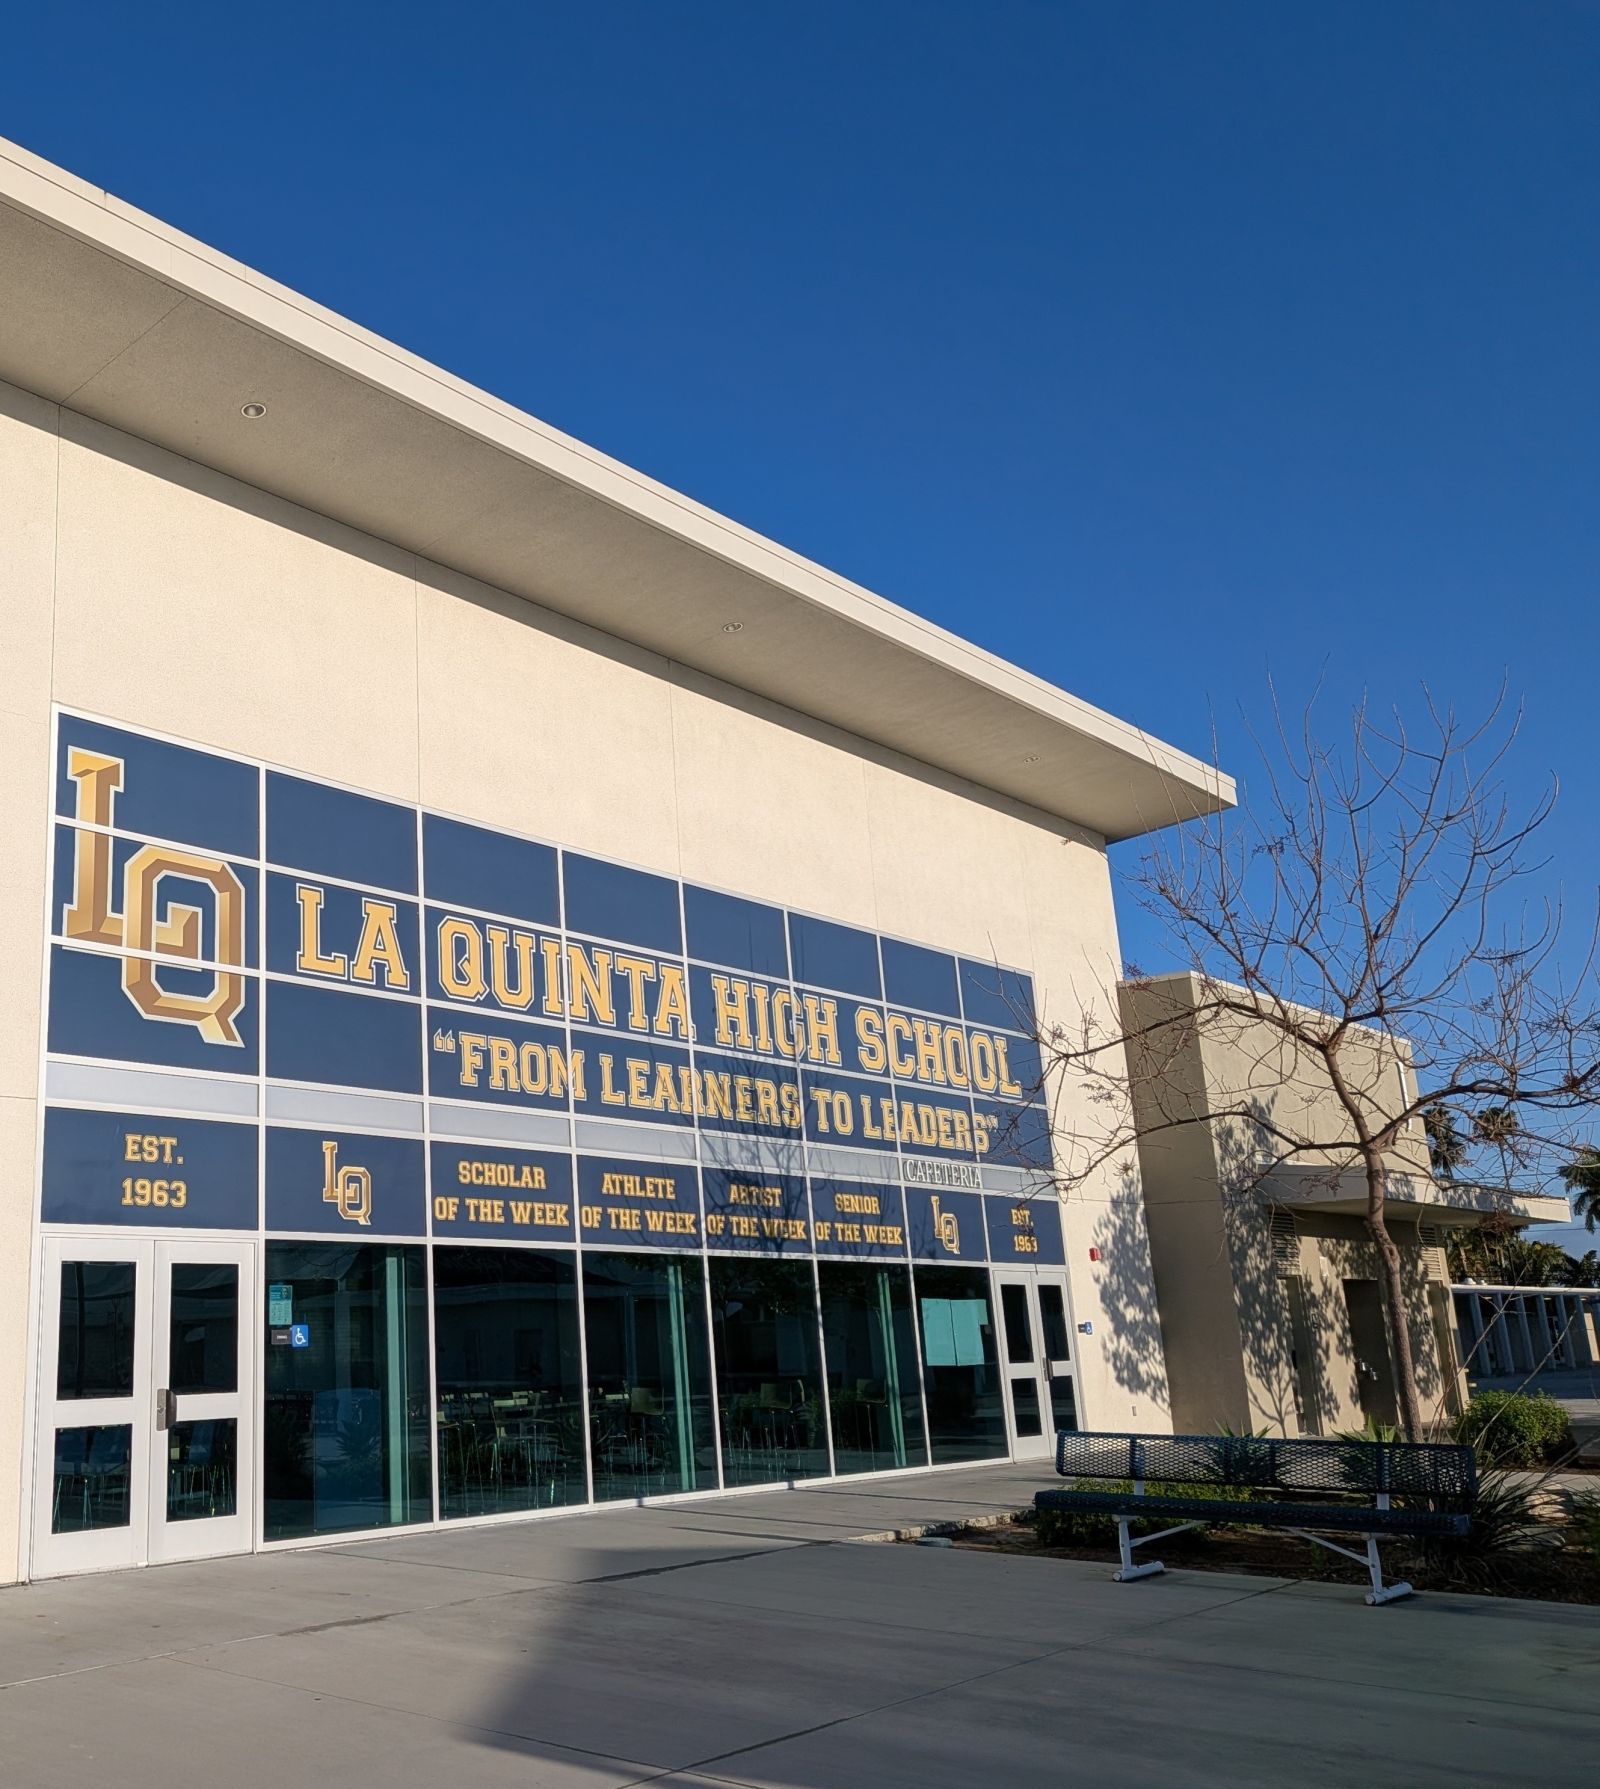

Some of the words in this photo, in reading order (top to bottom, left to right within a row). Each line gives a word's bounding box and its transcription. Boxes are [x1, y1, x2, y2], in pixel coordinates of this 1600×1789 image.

[295, 883, 410, 991] LA
[437, 915, 696, 1040] QUINTA
[711, 973, 841, 1067] HIGH
[855, 1005, 1022, 1098] SCHOOL
[599, 1053, 800, 1129] LEARNERS
[810, 1086, 853, 1135] TO
[125, 1133, 183, 1166] EST.
[458, 1160, 546, 1190] SCHOLAR
[601, 1172, 676, 1201] ATHLETE
[906, 1160, 983, 1188] CAFETERIA
[121, 1177, 187, 1208] 1963
[729, 1184, 783, 1208] ARTIST
[835, 1193, 880, 1215] SENIOR
[434, 1197, 459, 1222] OF
[465, 1198, 505, 1224] THE
[509, 1200, 569, 1225] WEEK
[580, 1205, 602, 1229] OF
[607, 1207, 642, 1232] THE
[646, 1210, 696, 1235] WEEK
[707, 1214, 725, 1235] OF
[730, 1216, 759, 1238] THE
[761, 1217, 807, 1240] WEEK
[815, 1221, 832, 1240] OF
[835, 1222, 861, 1243] THE
[863, 1224, 903, 1245] WEEK
